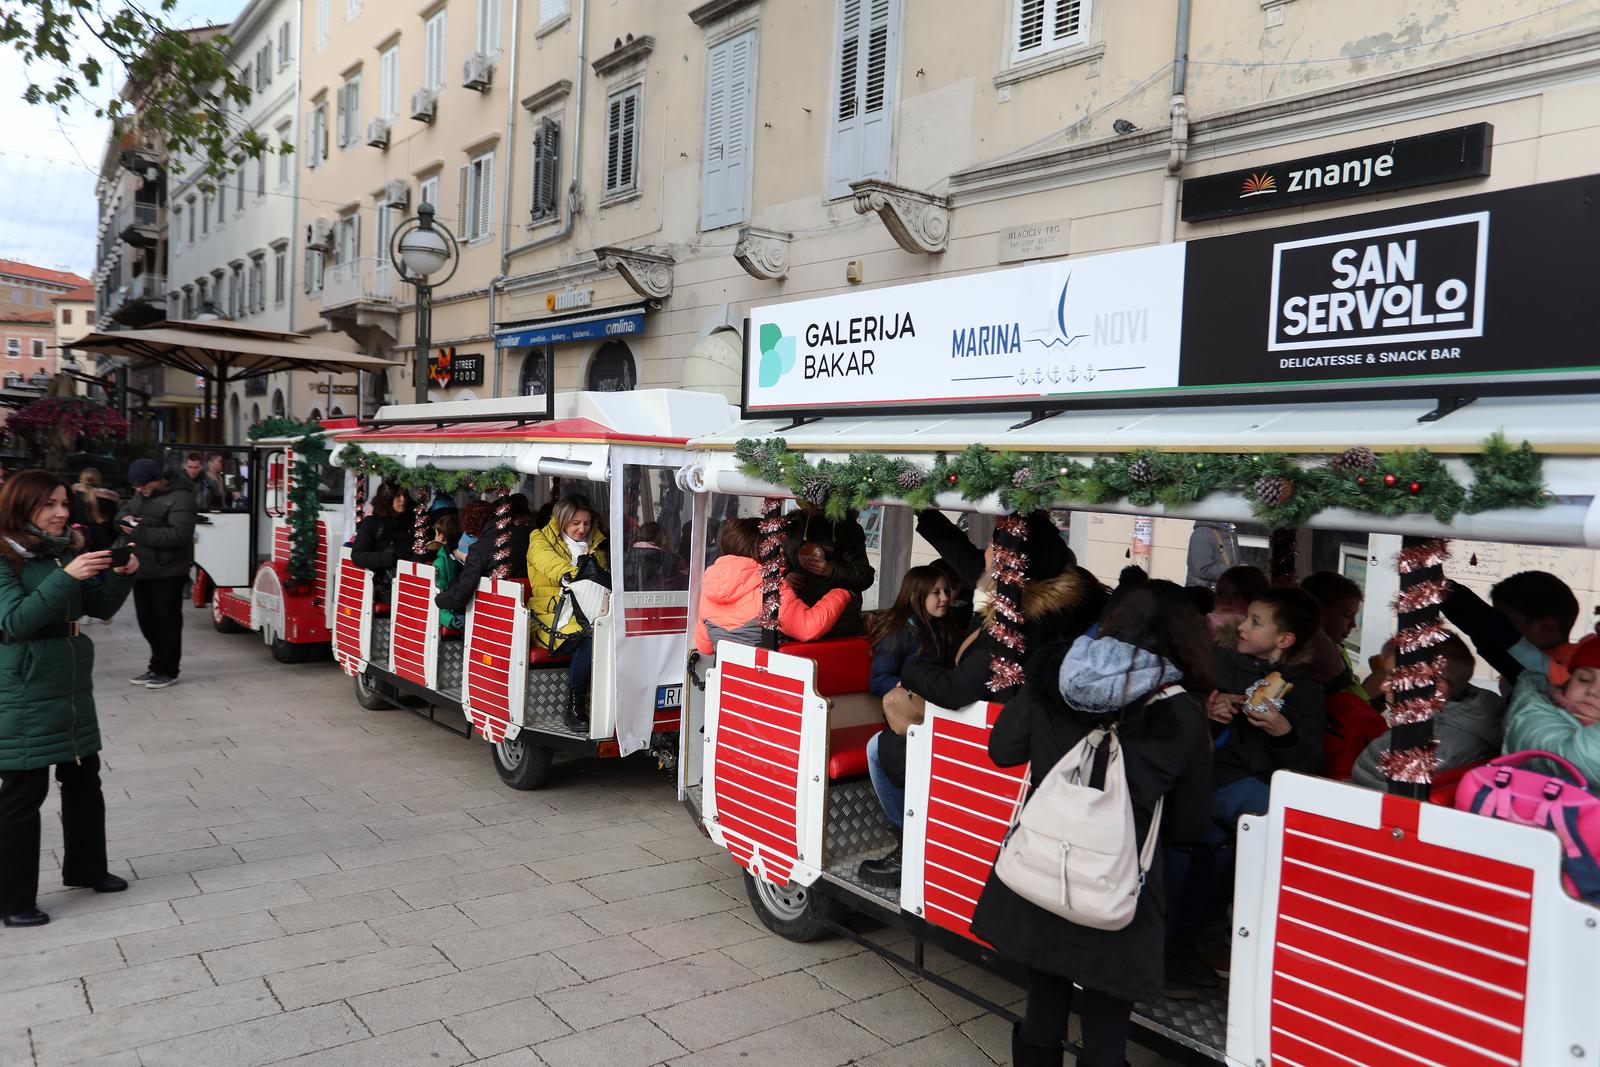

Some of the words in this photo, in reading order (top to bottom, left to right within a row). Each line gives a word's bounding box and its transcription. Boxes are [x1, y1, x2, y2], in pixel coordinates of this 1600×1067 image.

[1286, 153, 1395, 194] znanje
[1331, 239, 1417, 290] SAN
[1282, 278, 1468, 337] SERVOLO
[805, 311, 915, 348] GALERIJA
[952, 322, 1022, 358] MARINA
[1094, 308, 1149, 347] NOVI
[454, 371, 476, 381] FOOD
[455, 359, 476, 370] STREET
[804, 349, 875, 380] BAKAR
[1279, 353, 1362, 369] DELICATESSE
[1366, 353, 1376, 365] &
[1379, 349, 1427, 364] SNACK
[1431, 347, 1461, 360] BAR
